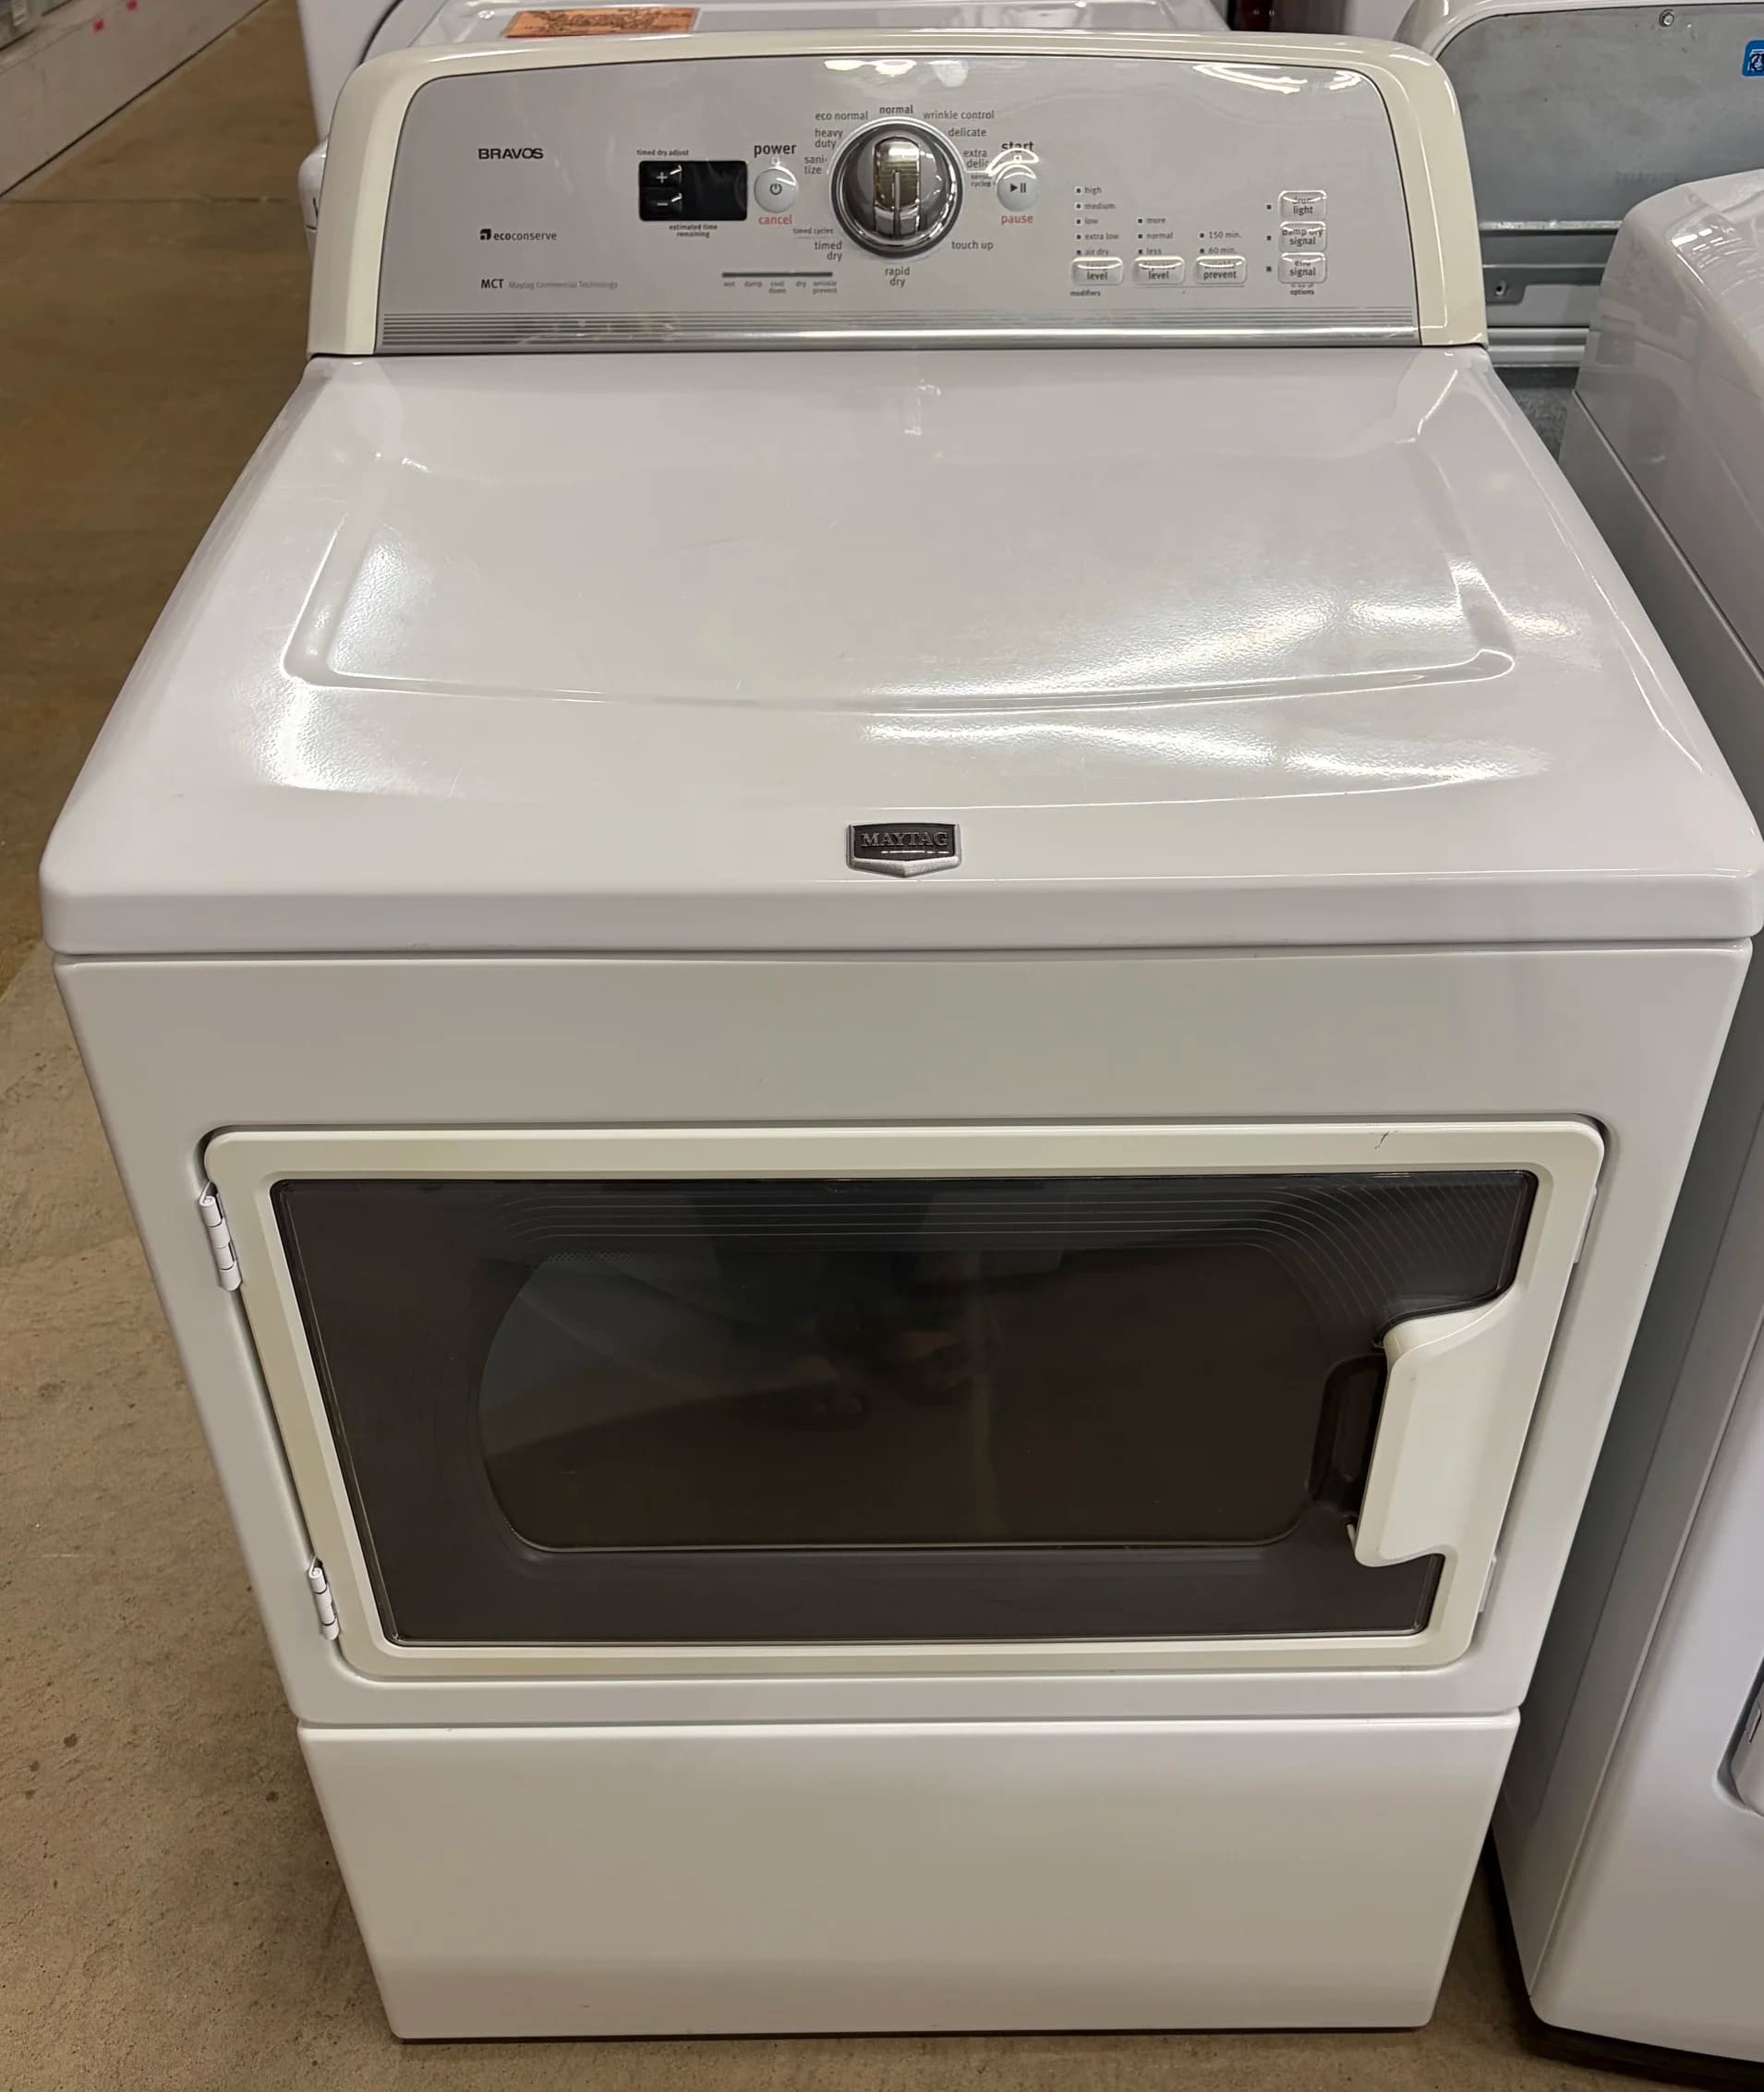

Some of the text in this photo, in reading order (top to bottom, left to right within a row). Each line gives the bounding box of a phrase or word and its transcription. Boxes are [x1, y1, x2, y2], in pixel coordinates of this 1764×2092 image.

[879, 104, 913, 115] normal
[815, 110, 868, 120] eco normal
[924, 110, 995, 120] wrinkle control
[815, 128, 843, 139] heavy
[948, 127, 987, 138] delicate
[815, 139, 837, 150] duty
[478, 148, 544, 160] BRAVOS
[657, 150, 668, 158] dry
[668, 149, 689, 158] adjust
[754, 144, 797, 158] power
[963, 149, 987, 158] extra
[804, 155, 828, 164] sani-
[804, 165, 822, 175] tize
[1085, 187, 1102, 196] high
[1084, 202, 1116, 211] medium
[1293, 206, 1313, 215] light
[758, 214, 793, 225] cancel
[1001, 214, 1034, 225] pause
[1084, 217, 1099, 225] low
[814, 227, 834, 236] cycles
[1146, 232, 1173, 240] normal
[1208, 231, 1242, 239] 150 min.
[493, 232, 557, 241] ecoconserve
[814, 241, 842, 250] timed
[951, 240, 994, 251] touch up
[1289, 236, 1316, 247] signal
[1097, 248, 1109, 257] dry
[1146, 247, 1162, 255] less
[1208, 247, 1219, 255] 60
[827, 251, 842, 261] dry
[885, 266, 911, 277] rapid
[1086, 272, 1108, 280] level
[1148, 271, 1169, 280] level
[1203, 271, 1237, 281] prevent
[1289, 267, 1316, 278] signal
[480, 279, 619, 290] MCT Maytag Commercial Technology
[744, 280, 763, 289] damp
[795, 281, 806, 289] dry
[889, 276, 906, 287] dry
[1069, 289, 1101, 297] modifiers
[861, 831, 948, 848] MAYTAG
